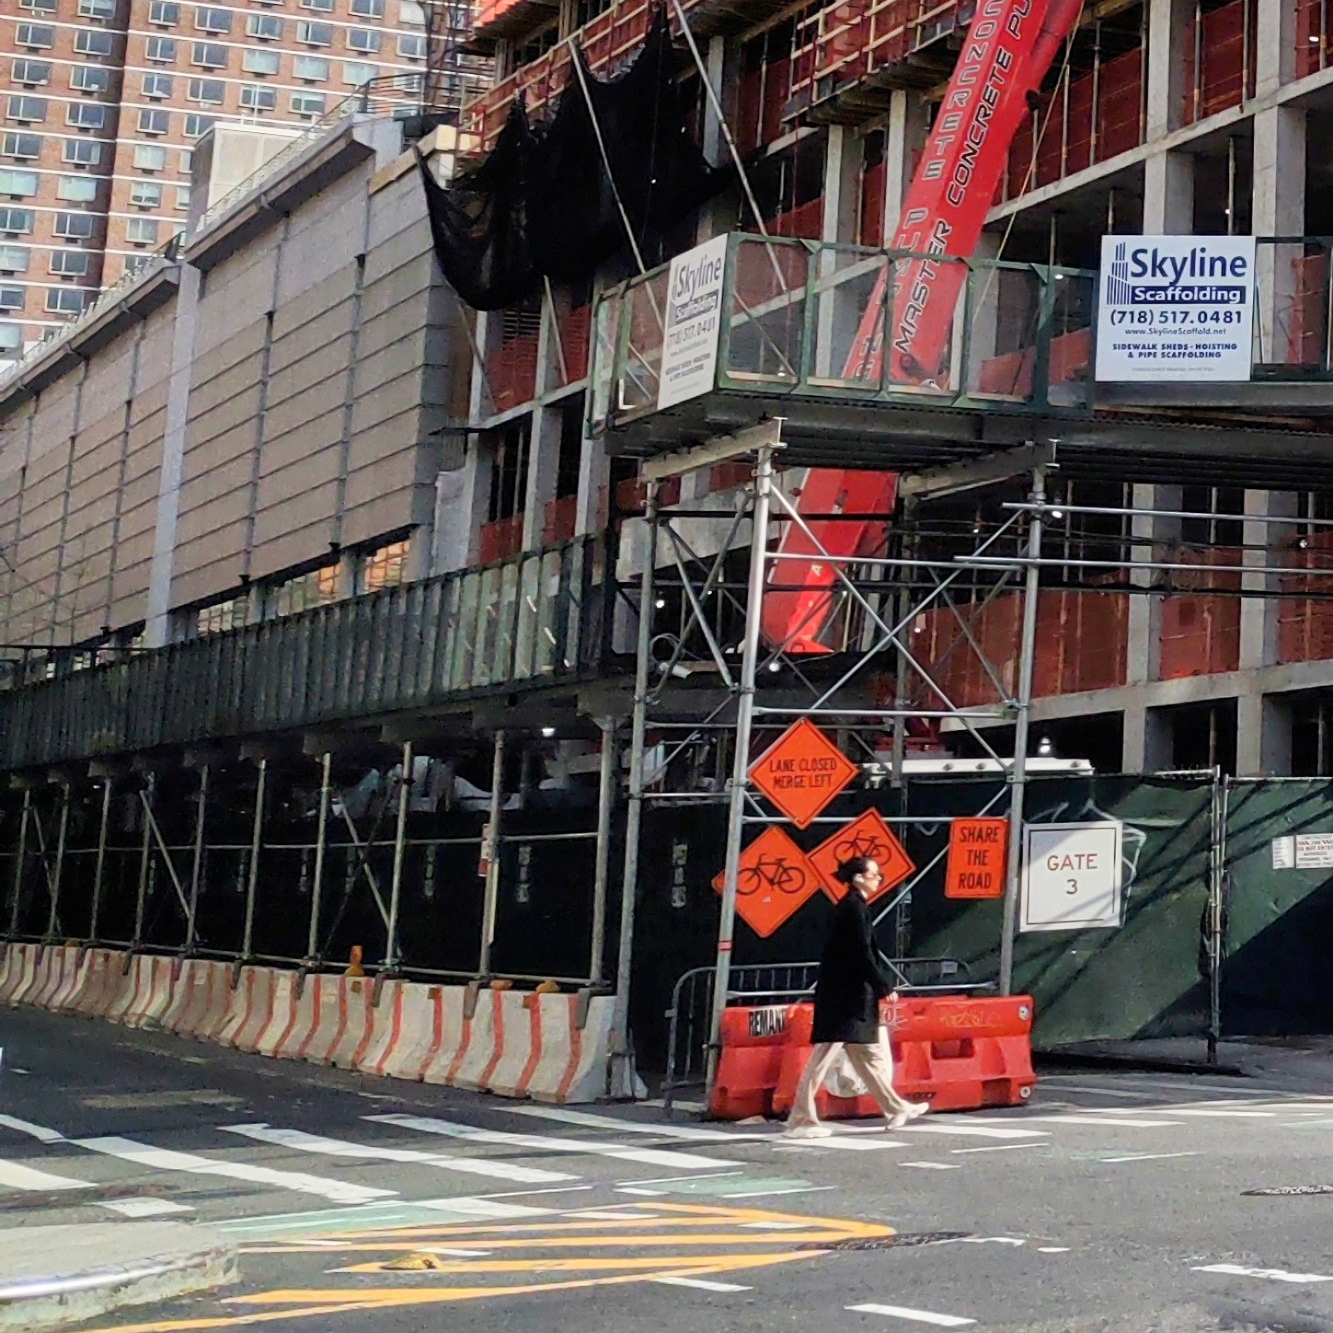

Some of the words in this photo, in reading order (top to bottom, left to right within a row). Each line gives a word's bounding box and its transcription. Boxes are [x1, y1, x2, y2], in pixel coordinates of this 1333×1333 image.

[947, 48, 1013, 207] CONCRETE
[1130, 247, 1247, 286] Skyline
[677, 255, 721, 299] Skyline
[893, 219, 952, 354] MASTER
[1134, 287, 1241, 304] Scaffolding
[1110, 309, 1154, 326] (718)
[1112, 343, 1158, 351] SIDEWALK
[1161, 343, 1189, 351] SHEDS
[1195, 343, 1238, 351] HOISTING
[1138, 351, 1157, 359] PIPE
[1161, 351, 1222, 359] SCAFFOLDING
[770, 759, 795, 773] LANE
[801, 757, 837, 771] CLOSED
[773, 775, 806, 789] MERGE
[809, 774, 832, 787] LEFT
[960, 826, 1000, 843] SHARE
[967, 849, 988, 866] THE
[1047, 853, 1098, 871] GATE
[958, 873, 992, 890] ROAD
[1066, 879, 1078, 895] 3
